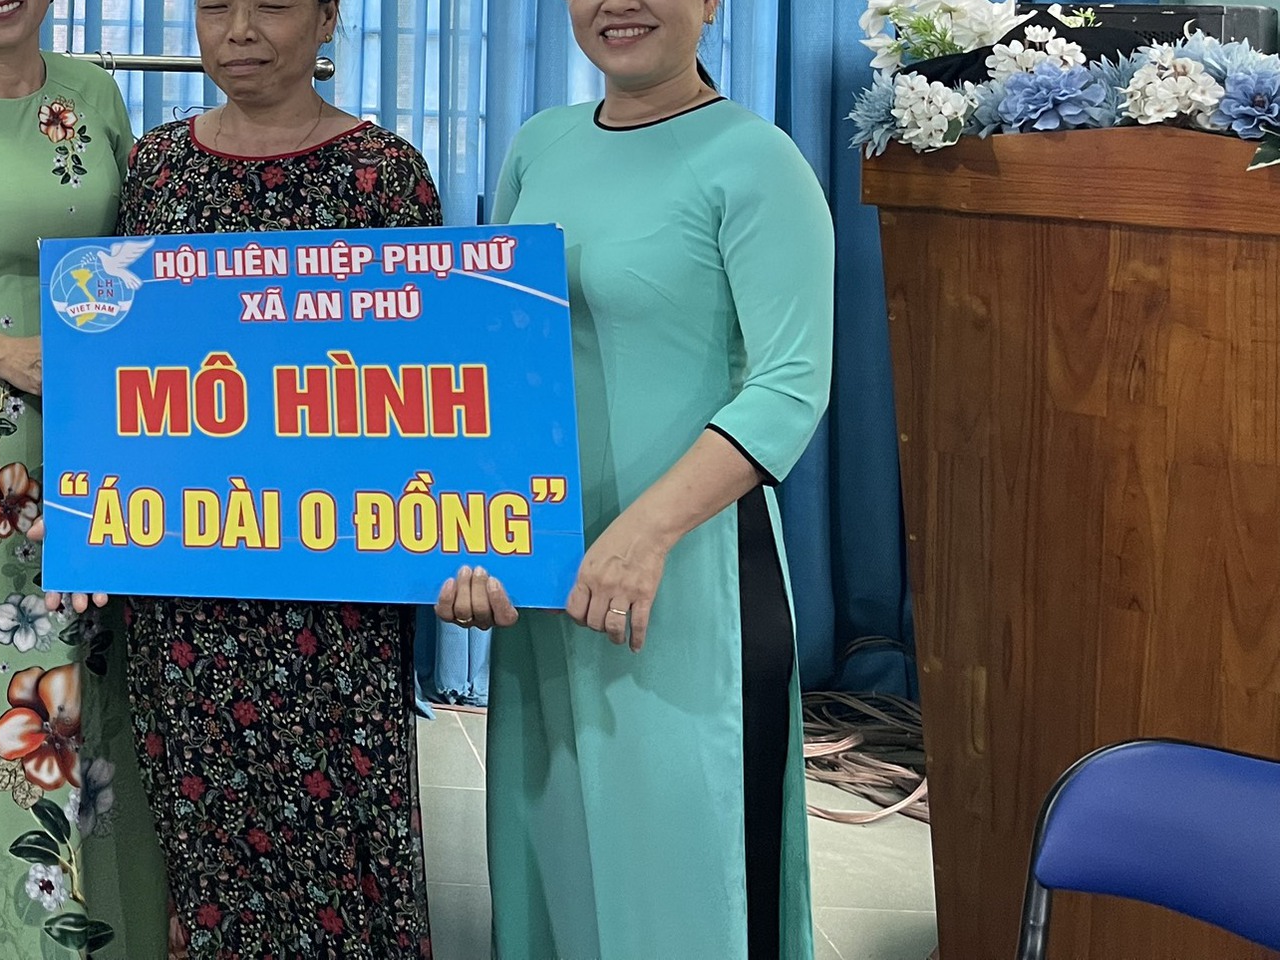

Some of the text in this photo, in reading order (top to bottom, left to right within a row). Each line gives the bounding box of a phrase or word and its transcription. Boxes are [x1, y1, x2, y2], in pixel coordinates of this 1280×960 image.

[154, 236, 517, 284] HỘI LIÊN HIỆP PHỤ NỮ
[94, 303, 116, 314] NAM
[240, 285, 421, 322] XÃ AN PHÚ
[116, 350, 491, 438] MÔ HÌNH
[182, 476, 282, 550] DÀI
